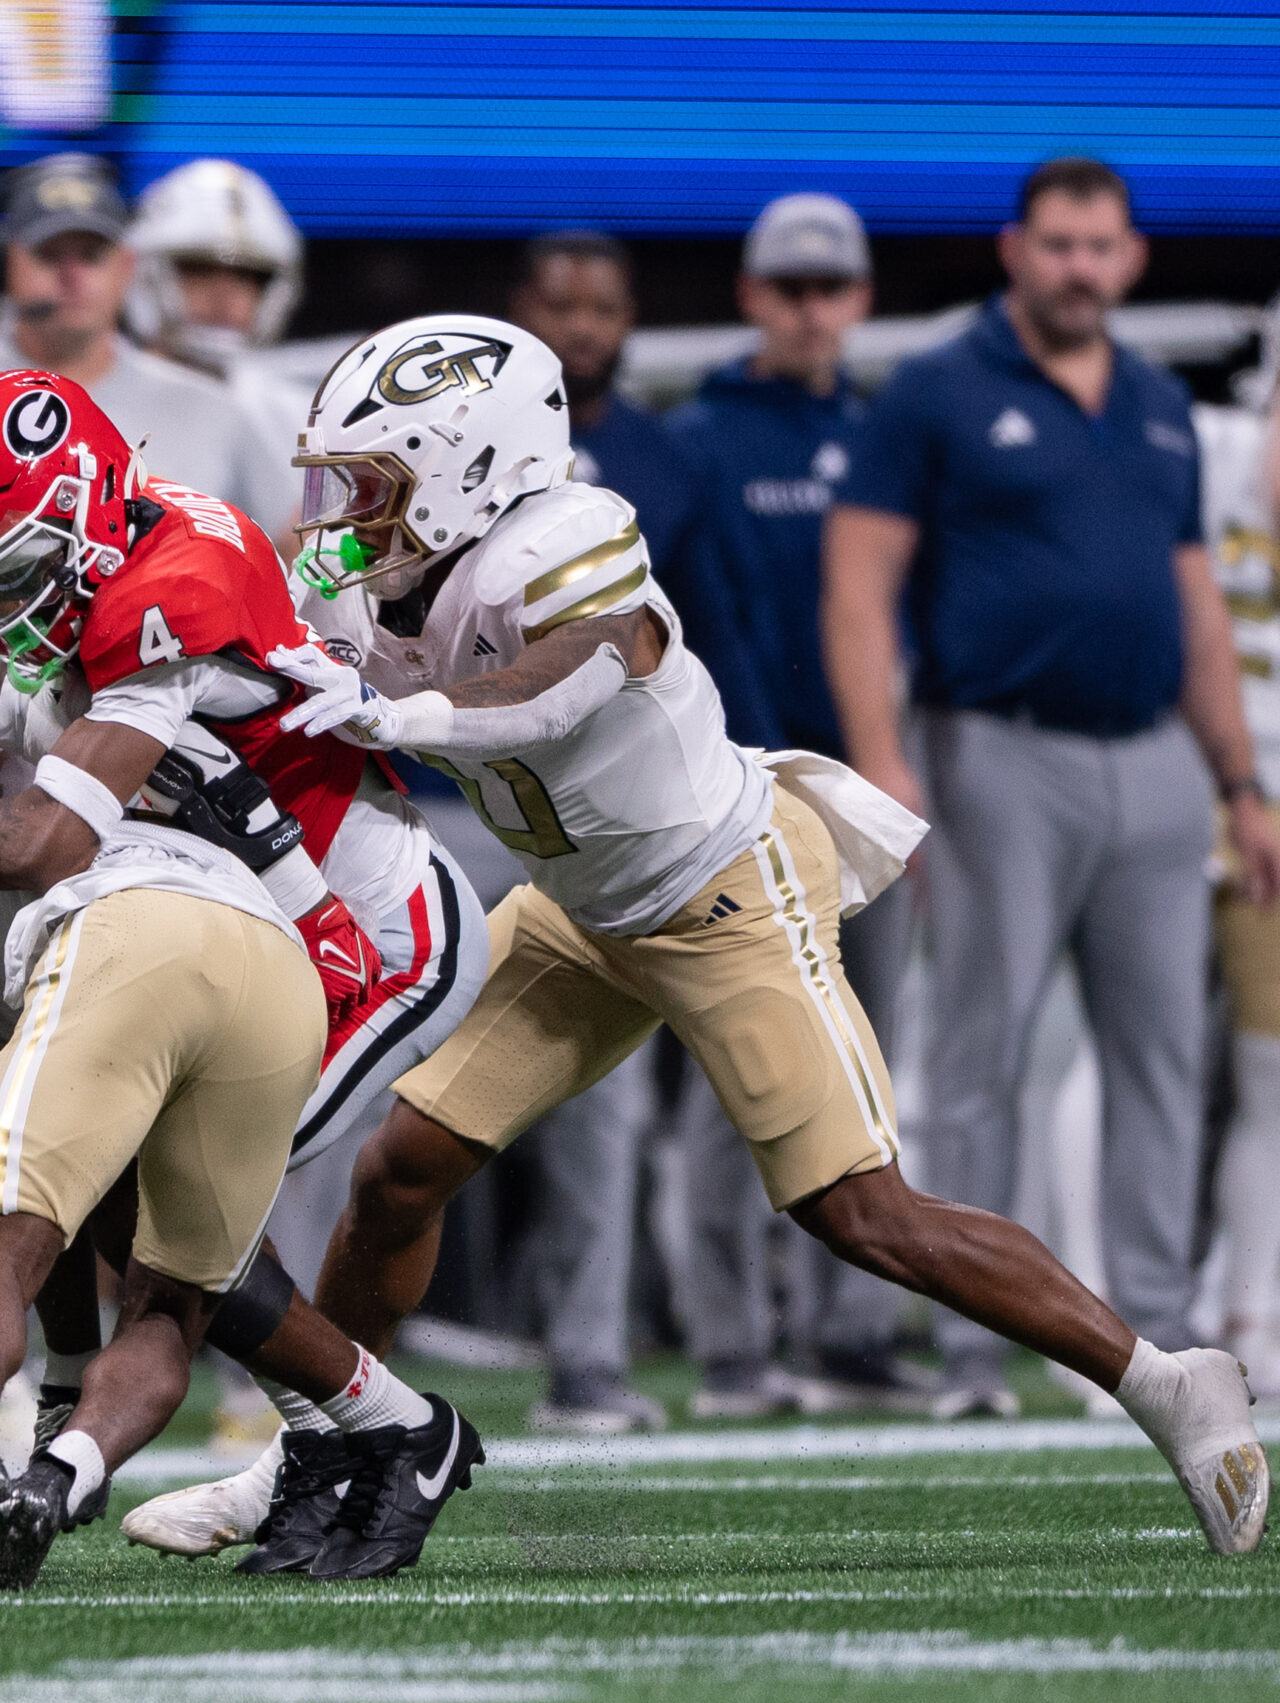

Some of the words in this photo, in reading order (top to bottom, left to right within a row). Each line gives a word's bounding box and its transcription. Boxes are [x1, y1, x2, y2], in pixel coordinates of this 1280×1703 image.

[377, 339, 505, 406] GT
[5, 390, 70, 459] G
[137, 603, 188, 668] 4
[327, 644, 356, 663] ACC
